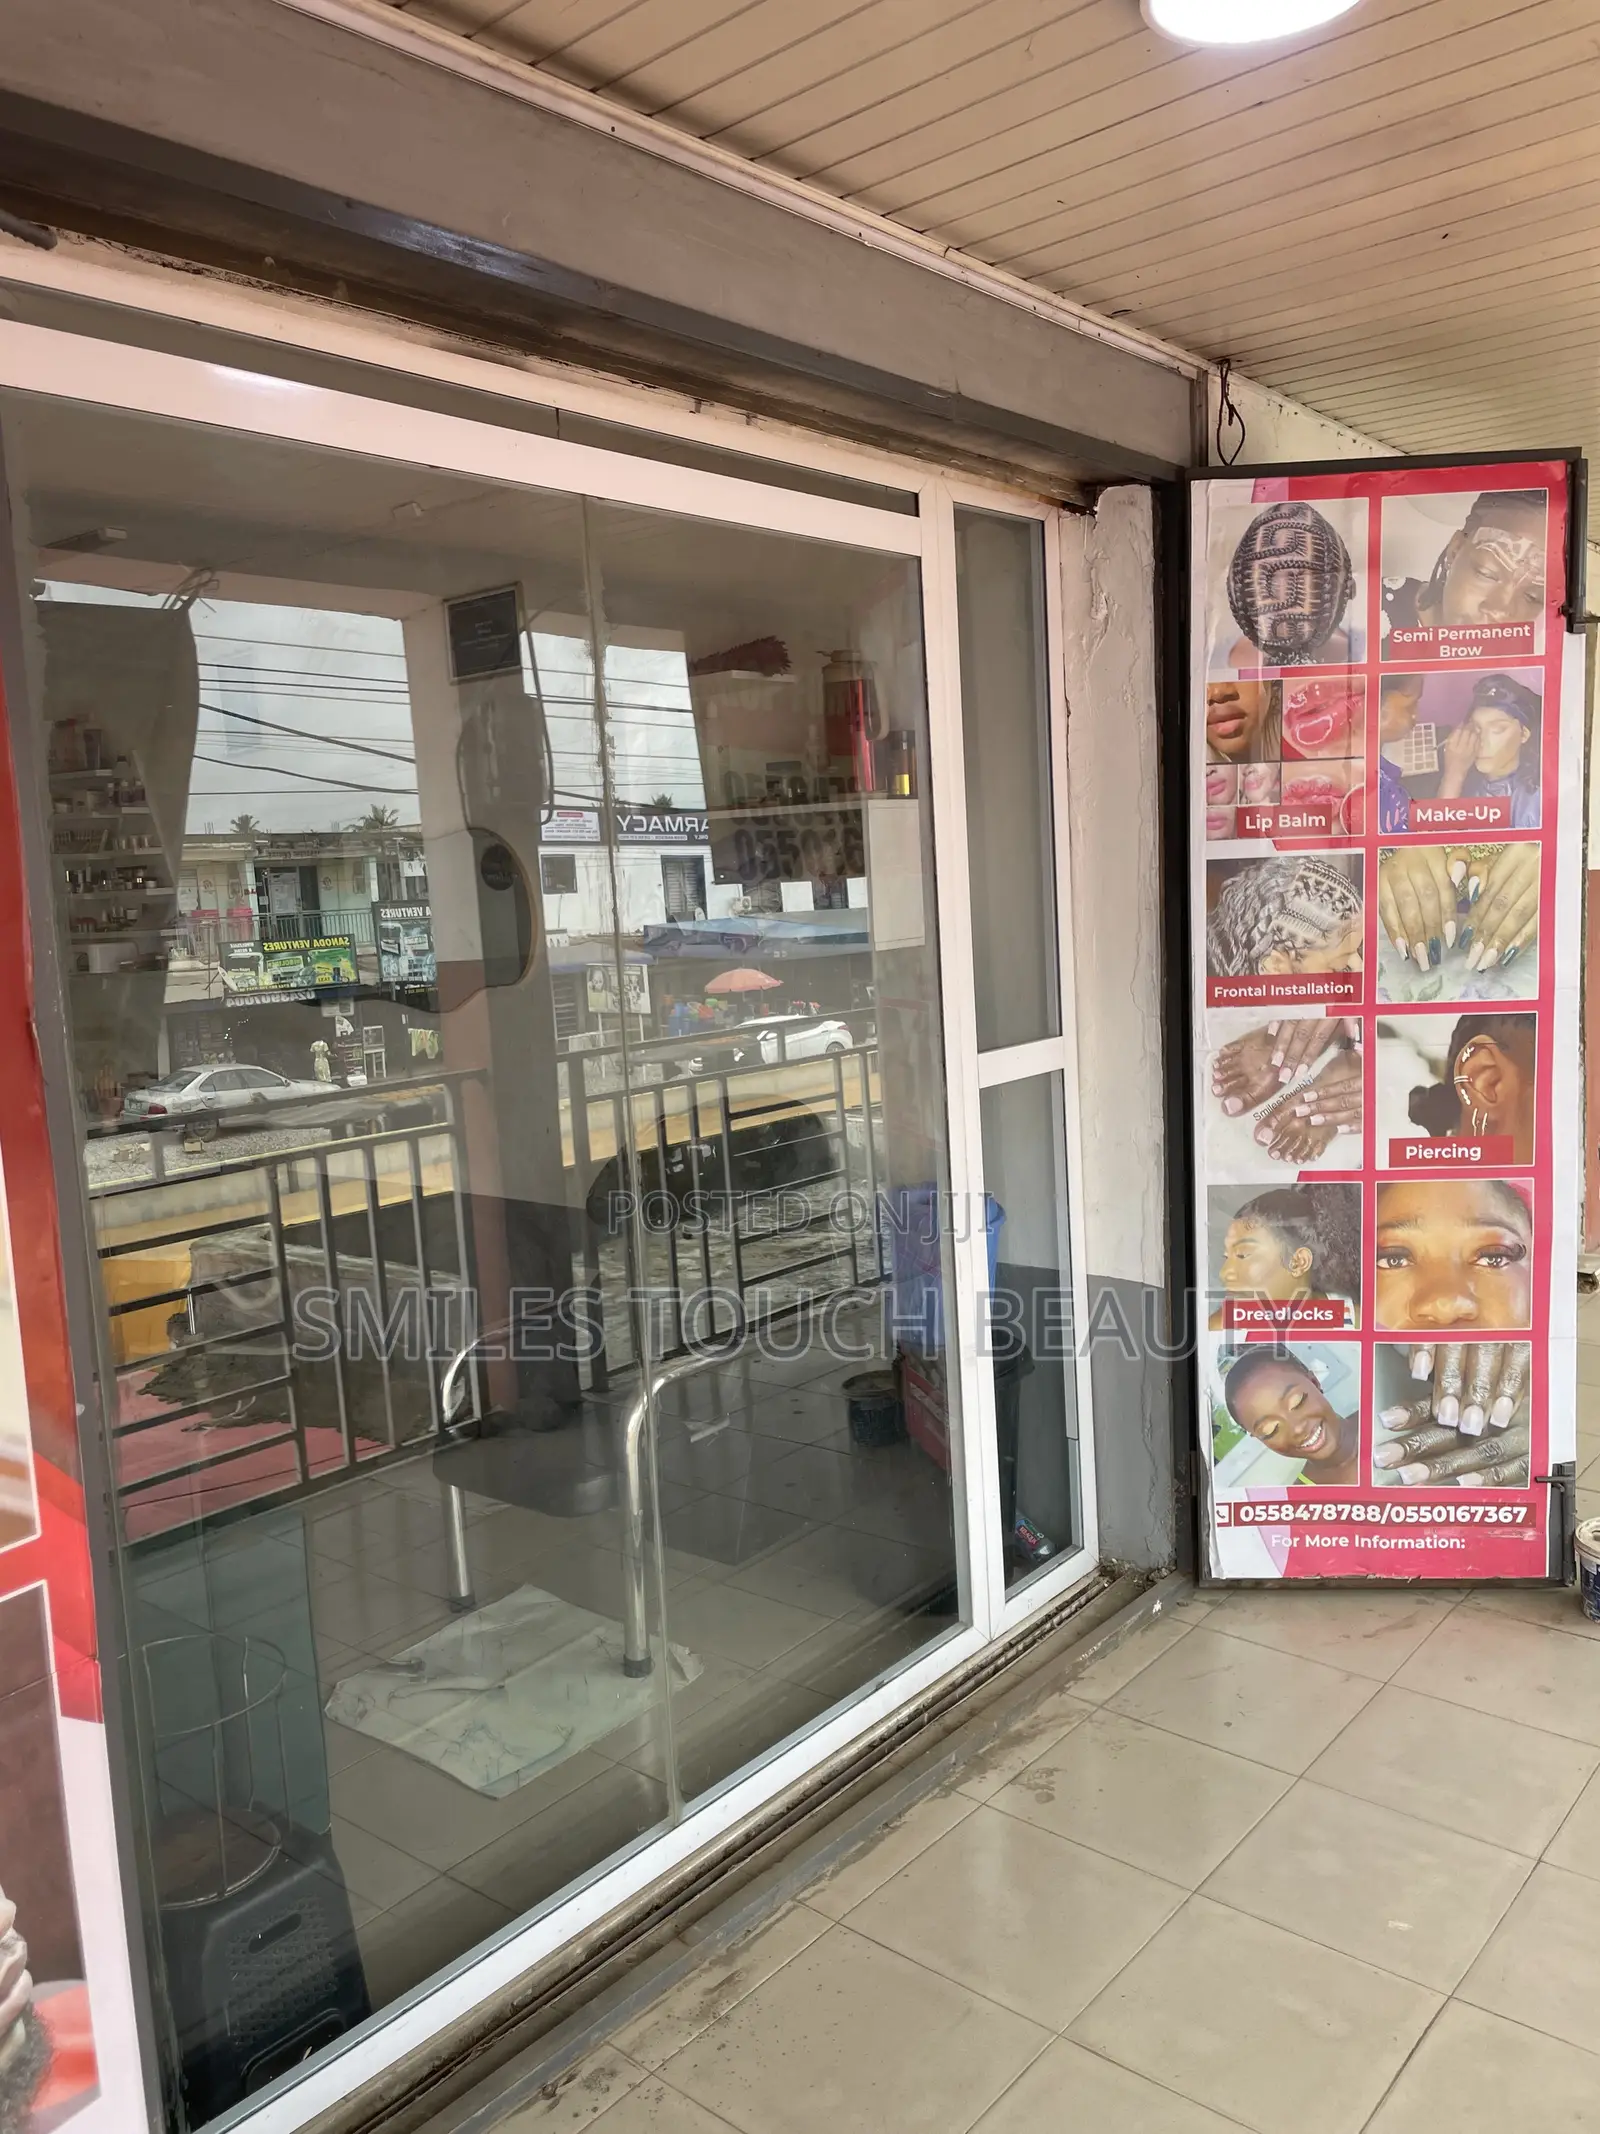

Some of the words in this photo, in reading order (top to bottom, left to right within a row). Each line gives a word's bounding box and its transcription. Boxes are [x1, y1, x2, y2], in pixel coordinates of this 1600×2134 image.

[1393, 629, 1433, 643] Semi
[1437, 624, 1531, 642] Permanent
[1439, 643, 1483, 658] Brow
[1245, 816, 1273, 833] Lip
[1278, 811, 1327, 829] Balm
[1416, 804, 1502, 823] Make-Up
[1214, 985, 1266, 998] Frontal
[1270, 982, 1354, 996] Installation
[1405, 1144, 1482, 1161] Piercing
[1232, 1307, 1334, 1321] Dreadlocks
[1240, 1503, 1528, 1525] 0558478788/0550167367
[1271, 1535, 1300, 1548] For
[1305, 1534, 1350, 1548] More
[1354, 1533, 1466, 1550] Information:
